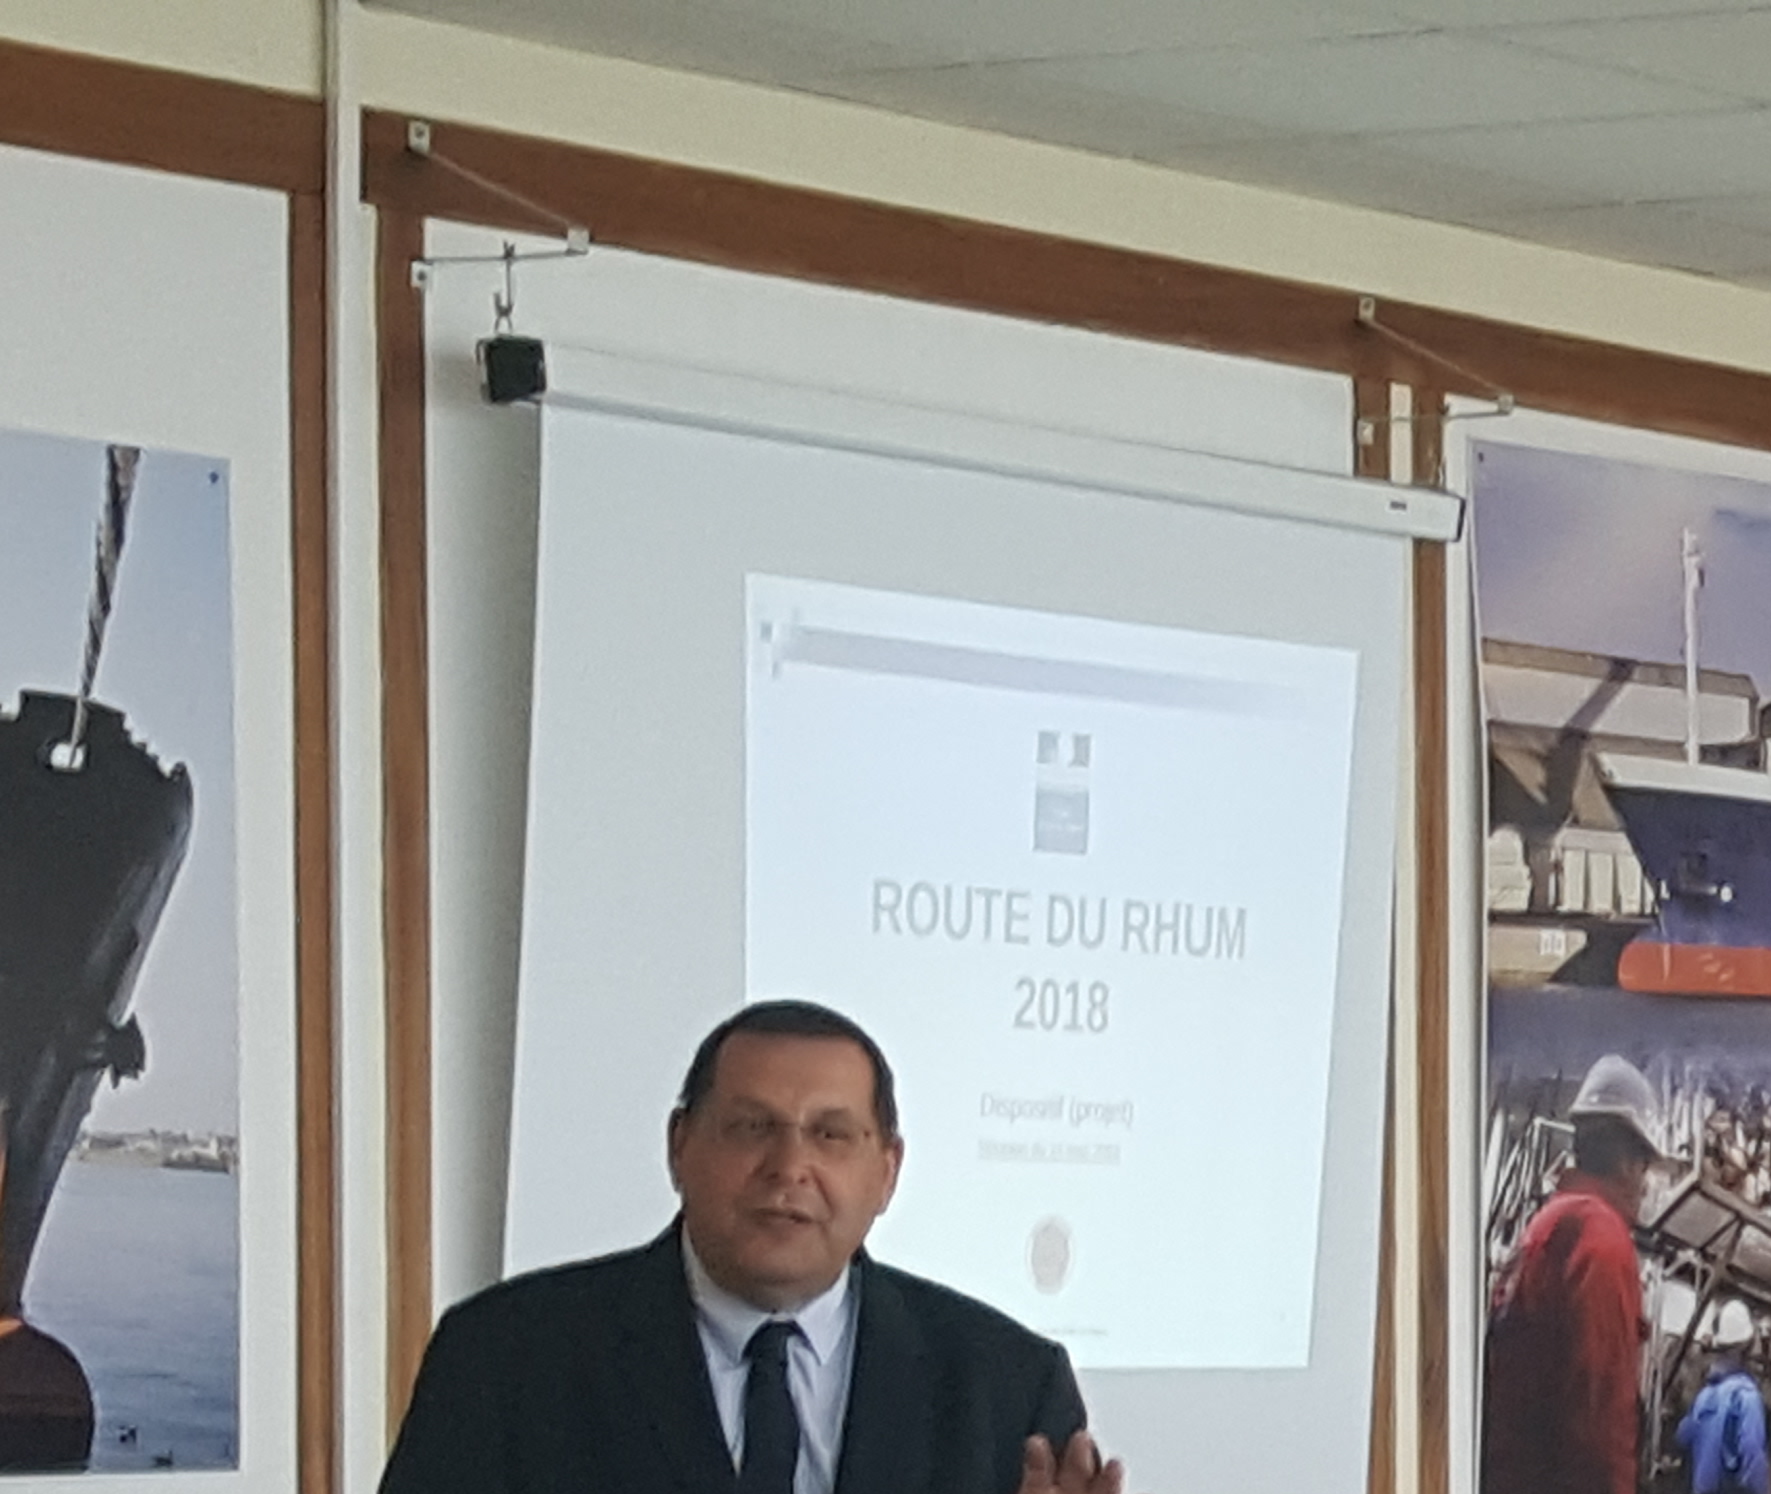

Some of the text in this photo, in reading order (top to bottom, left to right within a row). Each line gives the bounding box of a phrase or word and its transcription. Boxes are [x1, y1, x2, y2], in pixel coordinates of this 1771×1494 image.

[872, 878, 1248, 960] ROUTE DU RHUM
[1012, 975, 1111, 1034] 2018
